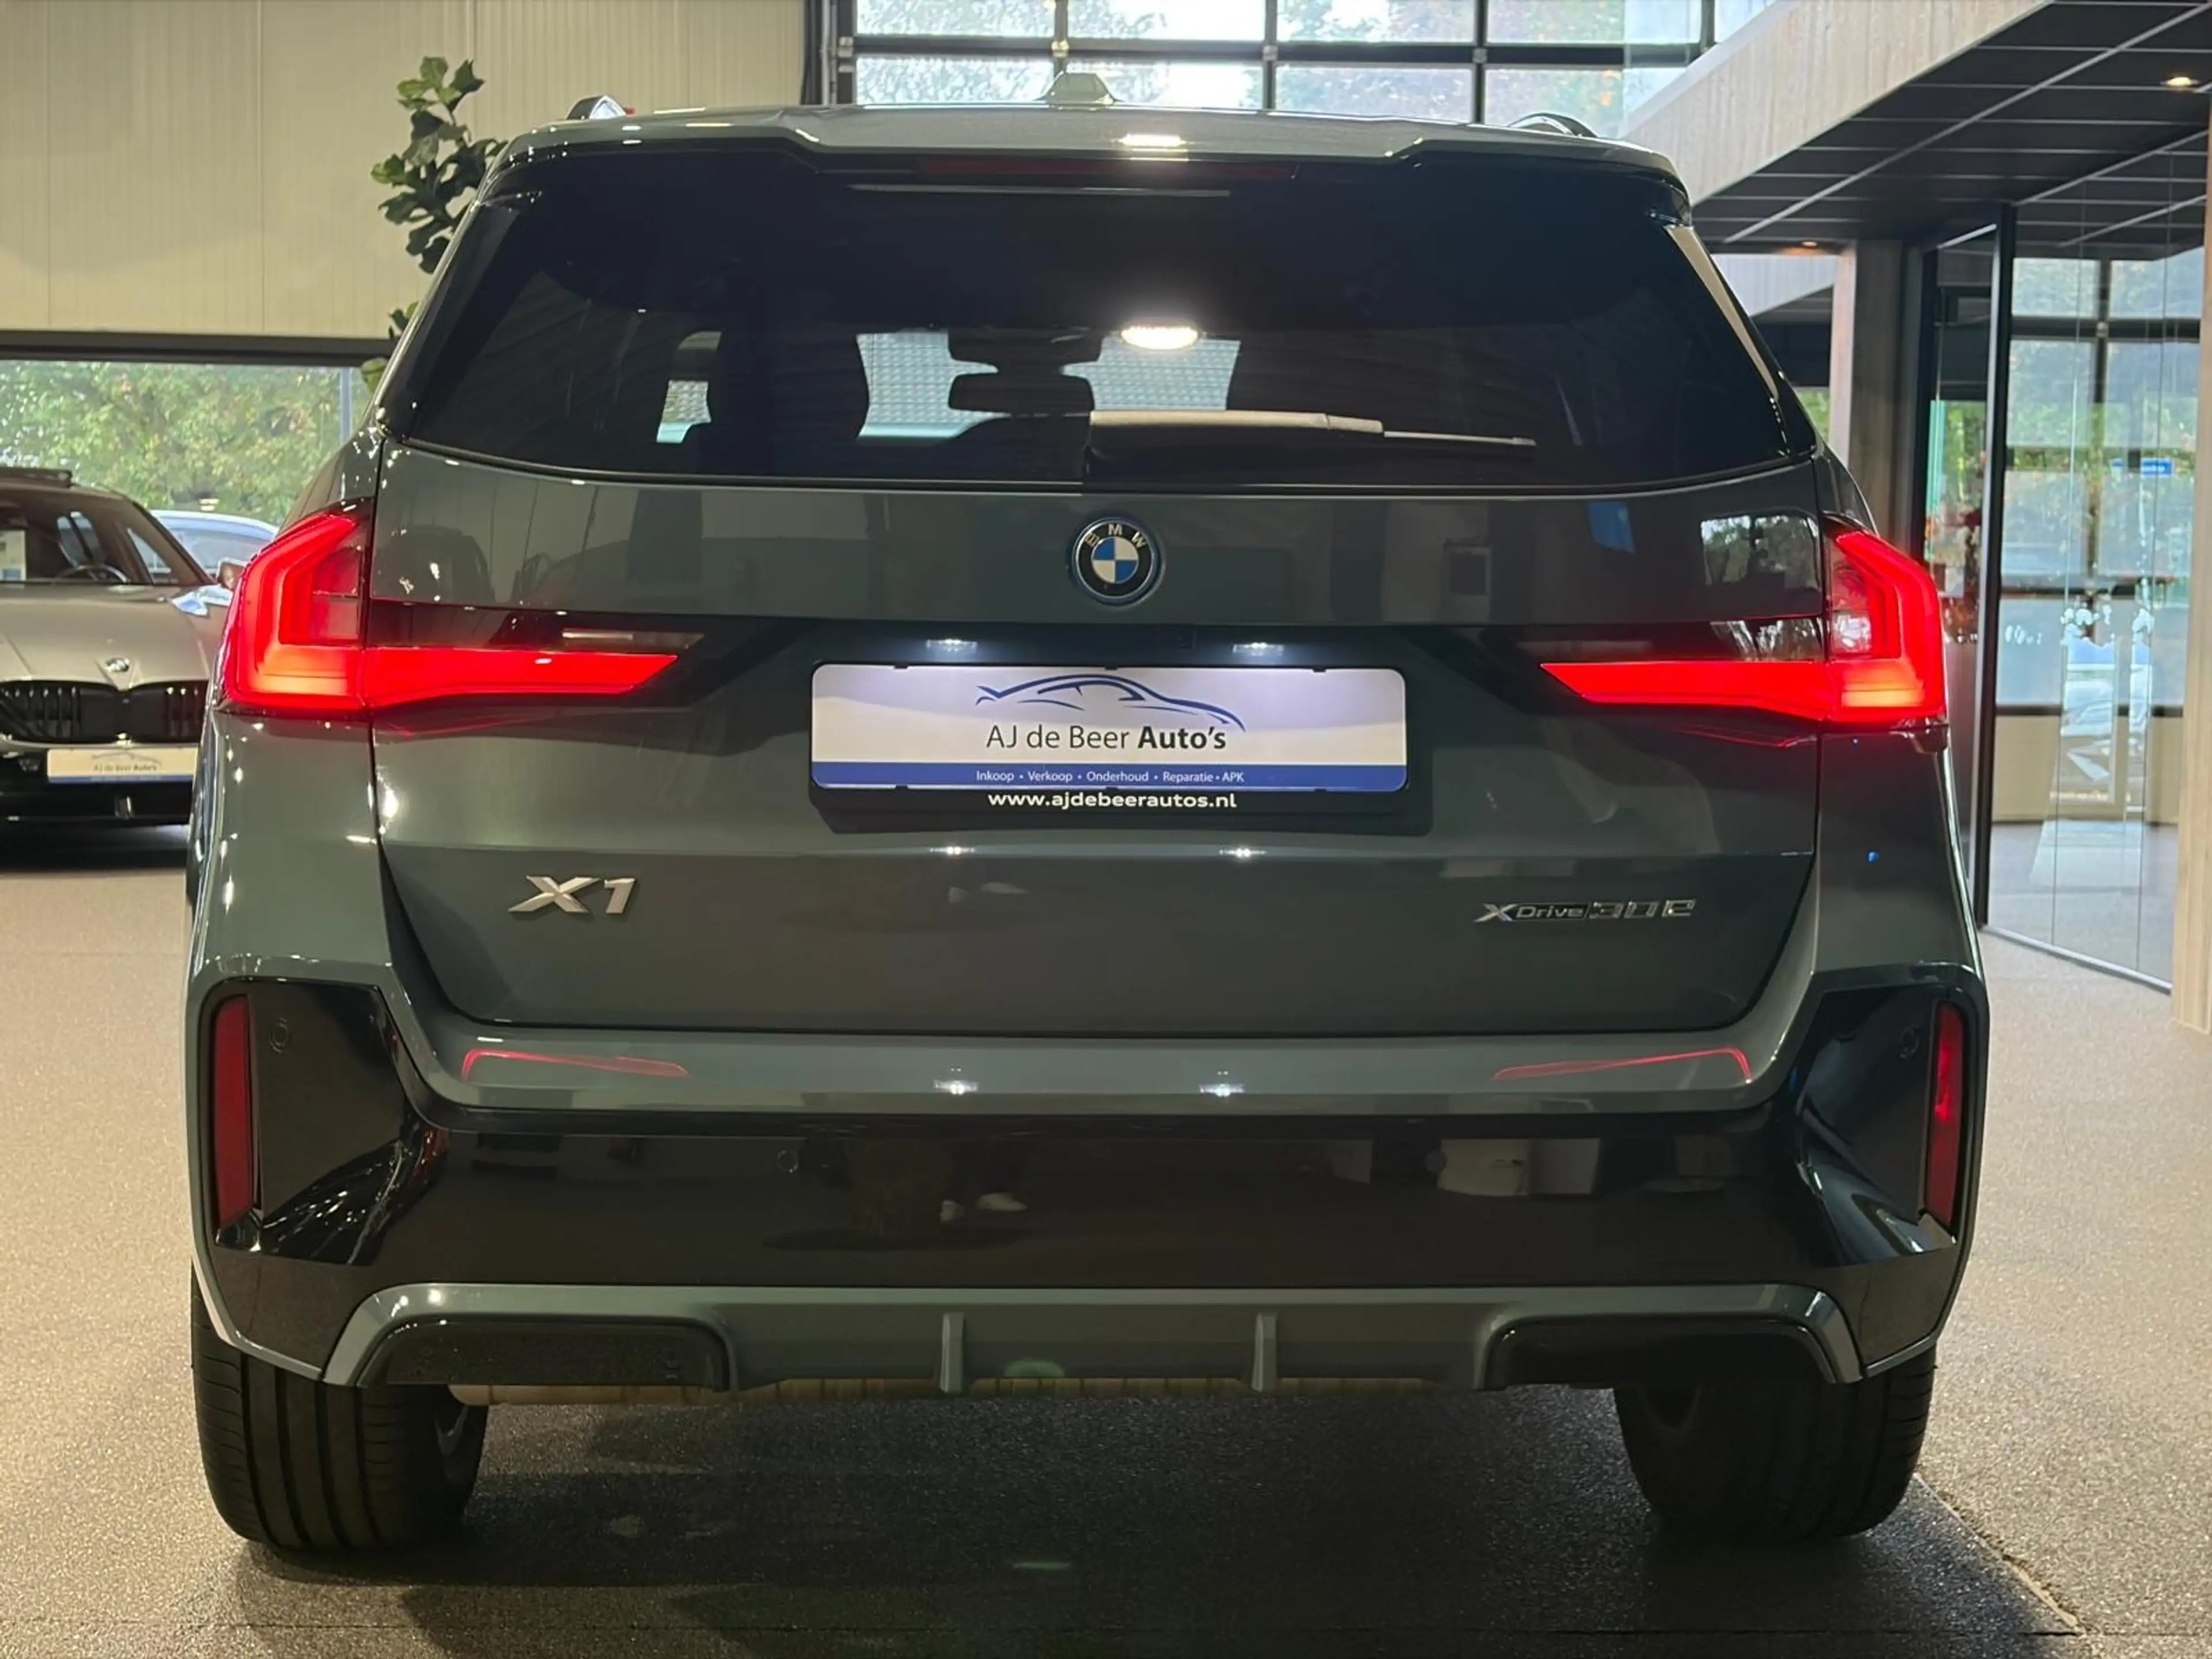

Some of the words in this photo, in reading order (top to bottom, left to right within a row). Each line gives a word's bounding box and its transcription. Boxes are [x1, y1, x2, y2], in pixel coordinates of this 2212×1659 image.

[1085, 524, 1147, 548] BMW
[987, 725, 1017, 748] AJ
[1027, 724, 1060, 748] de
[1070, 725, 1130, 749] Beer
[1138, 726, 1226, 749] Auto's
[976, 770, 1014, 782] Inkoop
[1028, 770, 1073, 783] Verkoop
[1086, 771, 1149, 782] Onderhoud
[1162, 771, 1214, 783] Reparatie
[1222, 771, 1245, 782] APK
[987, 791, 1238, 810] www.ajdebeerautos.nl
[507, 874, 636, 914] X1
